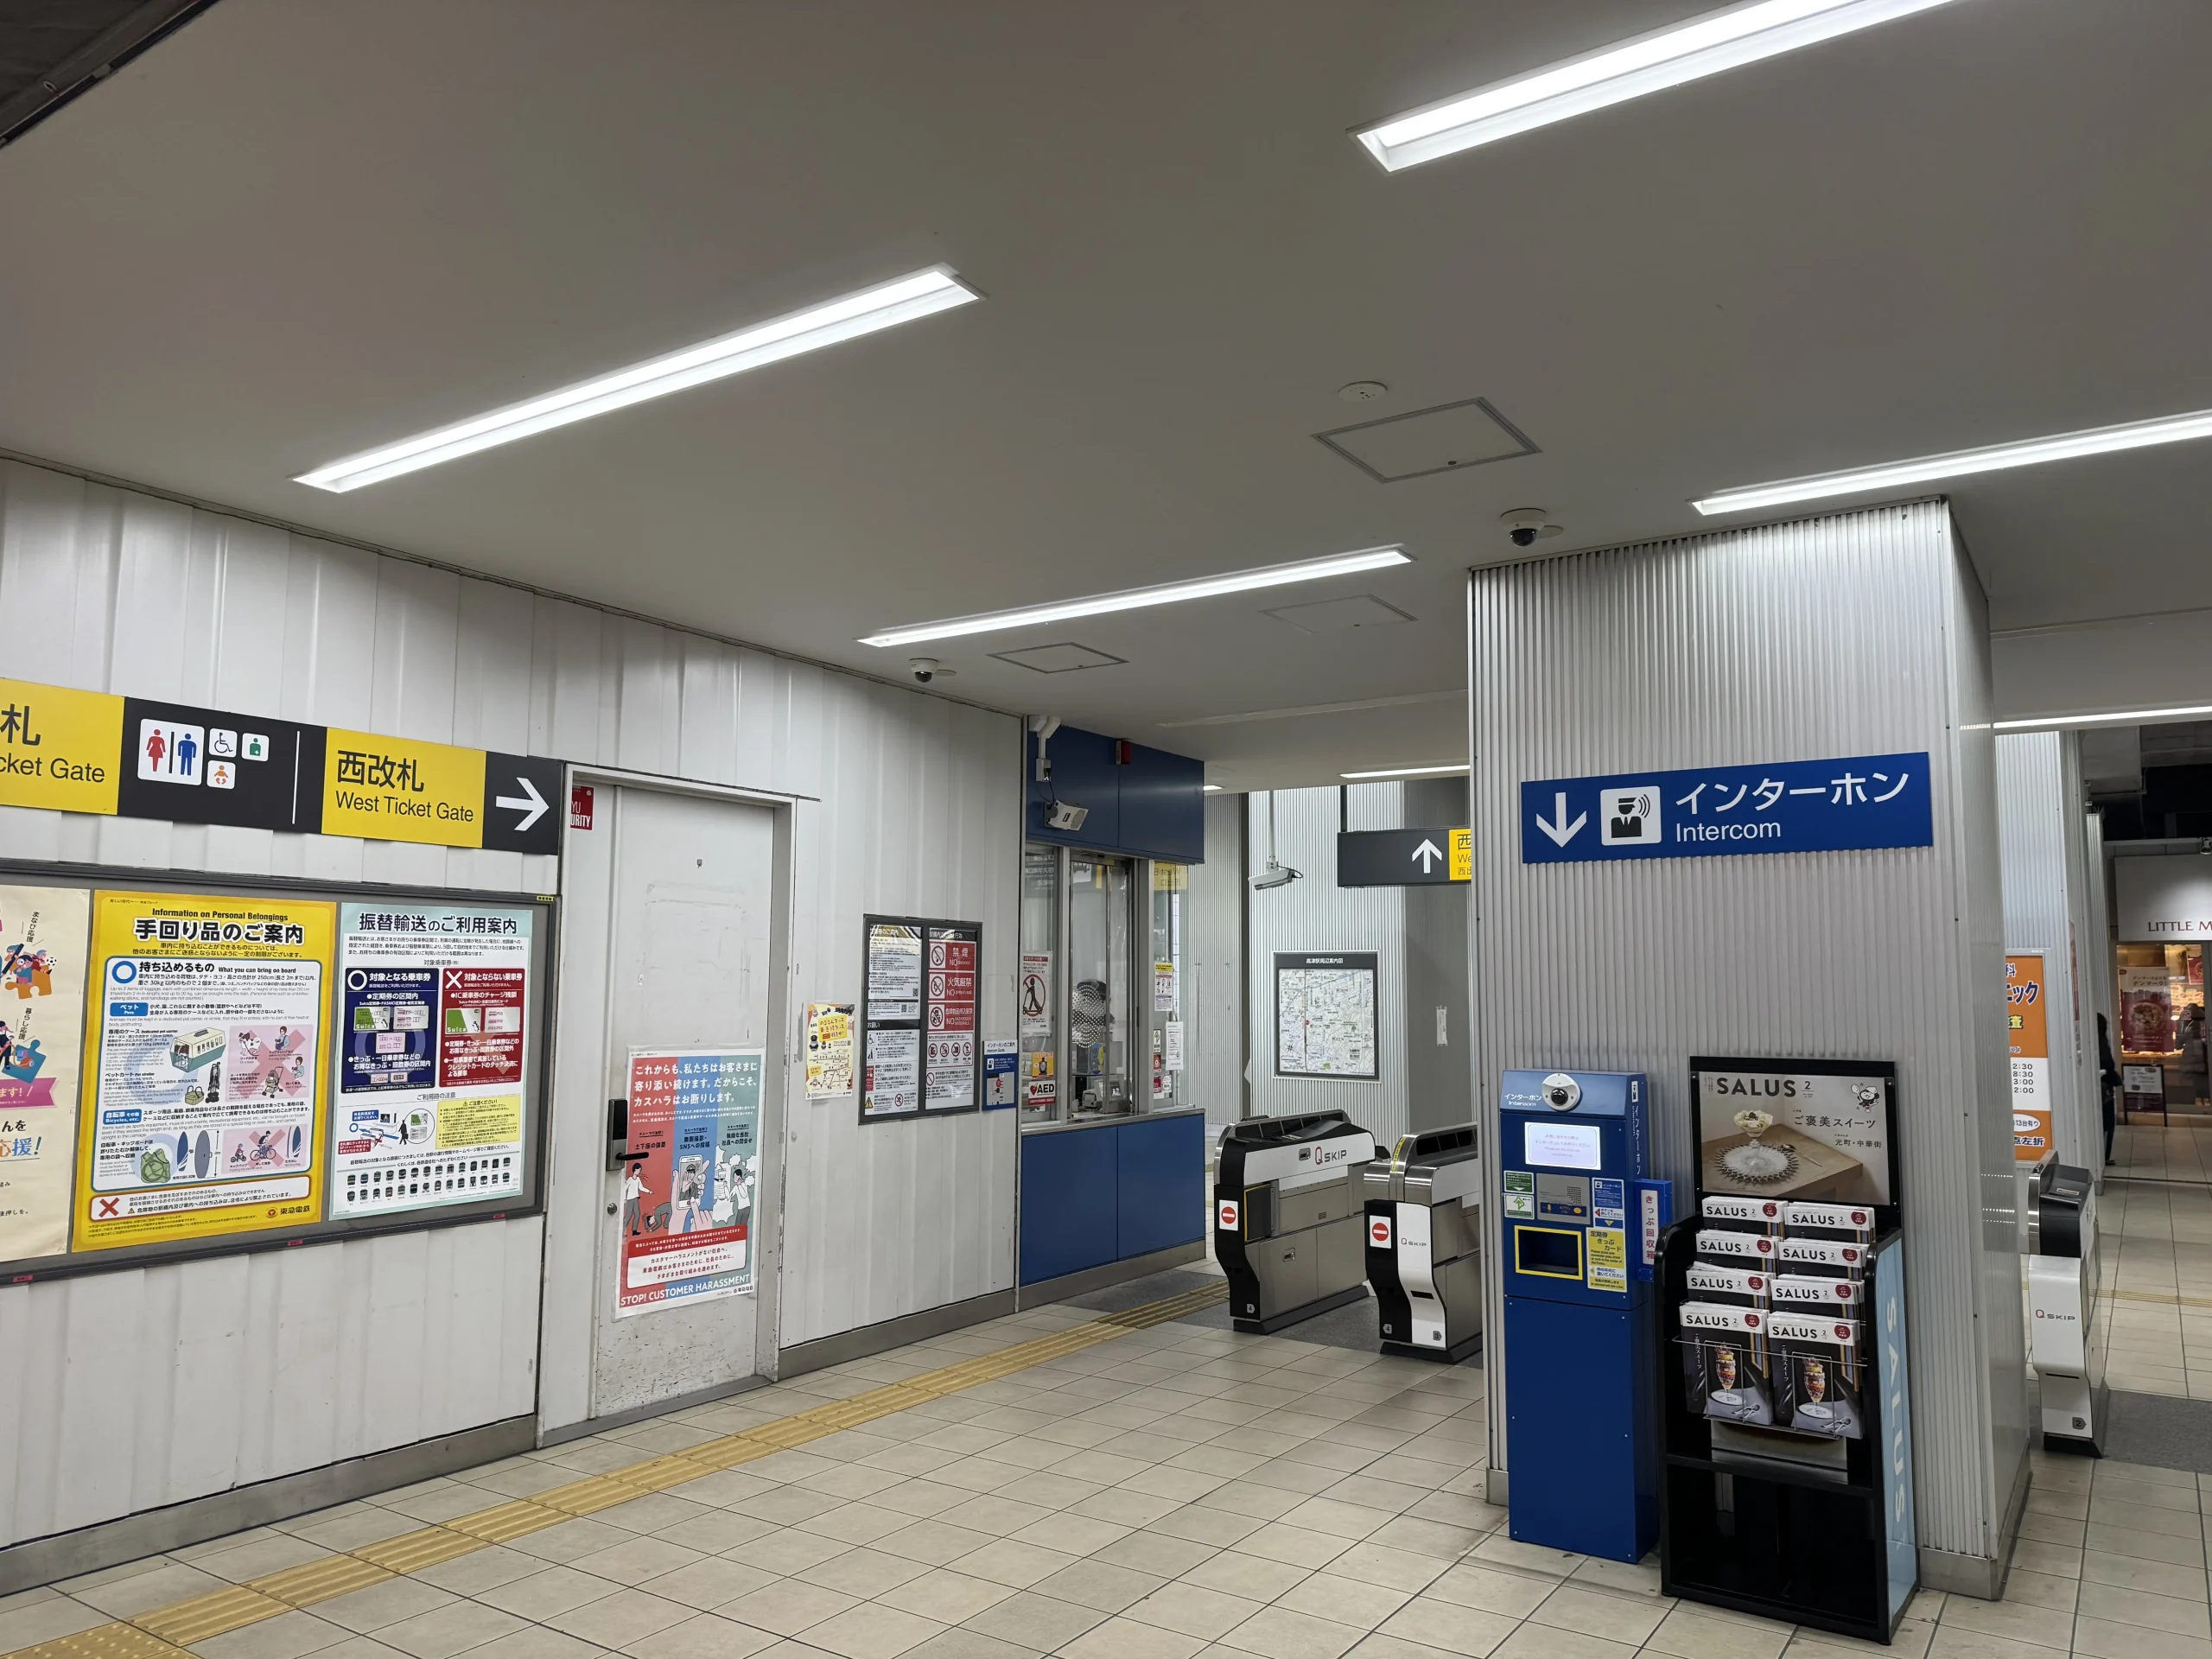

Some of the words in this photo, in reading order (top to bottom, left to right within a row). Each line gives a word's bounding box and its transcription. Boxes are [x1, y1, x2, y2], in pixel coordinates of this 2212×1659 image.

[0, 703, 41, 747] 札
[50, 759, 105, 784] Gate
[337, 749, 424, 793] 西改札
[1675, 772, 1910, 814] インターホン
[334, 791, 379, 814] West
[385, 796, 432, 819] Ticket
[435, 799, 474, 823] Gate
[1676, 821, 1781, 842] Intercom
[152, 908, 199, 918] Information
[213, 911, 245, 919] Personal
[248, 912, 289, 922] Belongings
[359, 913, 517, 934] 振替輸送のご利用案内
[2148, 921, 2194, 932] LITTLE
[136, 919, 303, 944] 手回り品のご案内
[139, 961, 215, 973] 持ち込めるもの
[369, 972, 431, 982] 対象となる乗車券
[464, 973, 523, 982] 対象とならない乗車券
[947, 977, 972, 987] 火気厳禁
[635, 1062, 758, 1076] これからも、私たちはお客さまに
[634, 1077, 757, 1092] 寄り添い続けます。だからこそ、
[1037, 1084, 1054, 1094] AED
[1716, 1077, 1796, 1097] SALUS
[1804, 1081, 1811, 1090] 2
[633, 1092, 736, 1108] カスハラはお断りします。
[1794, 1115, 1876, 1128] ご褒美スイーツ
[1835, 1139, 1882, 1148] 元町・中華街
[1314, 1147, 1324, 1166] Q
[1325, 1149, 1347, 1163] SKIP
[280, 1205, 310, 1216] 東急電鉄
[1707, 1205, 1747, 1217] SALUS
[1792, 1213, 1835, 1225] SALUS
[1645, 1195, 1656, 1260] きっぷ回収箱
[1401, 1237, 1408, 1246] Q
[1700, 1241, 1742, 1253] SALUS
[1783, 1248, 1826, 1261] SALUS
[1691, 1277, 1733, 1289] SALUS
[620, 1293, 647, 1306] STOP!
[649, 1285, 694, 1300] CUSTOMER
[696, 1274, 750, 1292] HARASSMENT
[1776, 1287, 1820, 1300] SALUS
[1686, 1314, 1729, 1326] SALUS
[2036, 1309, 2045, 1319] Q
[1772, 1325, 1817, 1338] SALUS
[1886, 1296, 1904, 1523] SALUS
